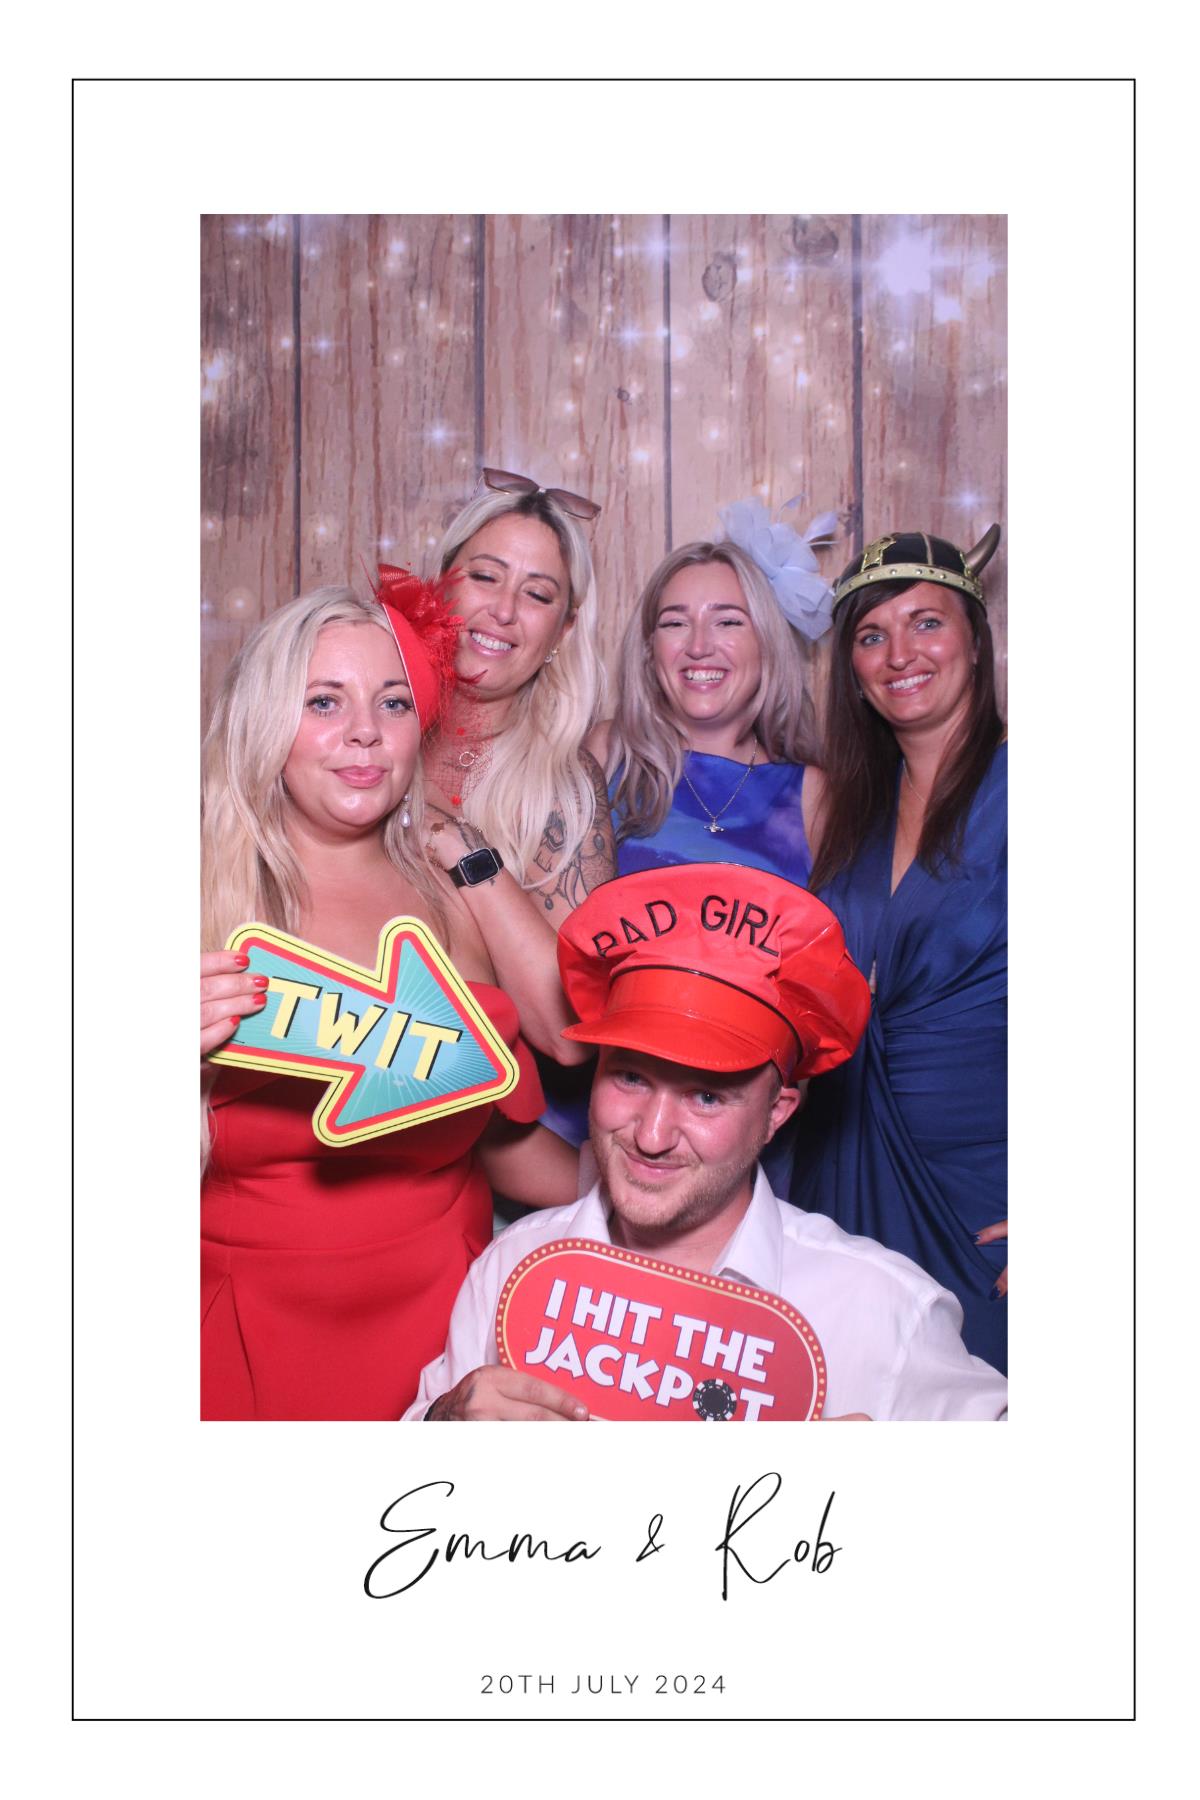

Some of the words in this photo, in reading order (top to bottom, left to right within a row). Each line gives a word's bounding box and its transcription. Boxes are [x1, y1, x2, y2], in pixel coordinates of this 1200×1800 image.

[591, 899, 678, 958] BAD
[700, 894, 780, 958] GIRL
[265, 976, 463, 1082] TWIT
[544, 1279, 567, 1320] I
[571, 1285, 663, 1345] HIT
[672, 1314, 775, 1383] THE
